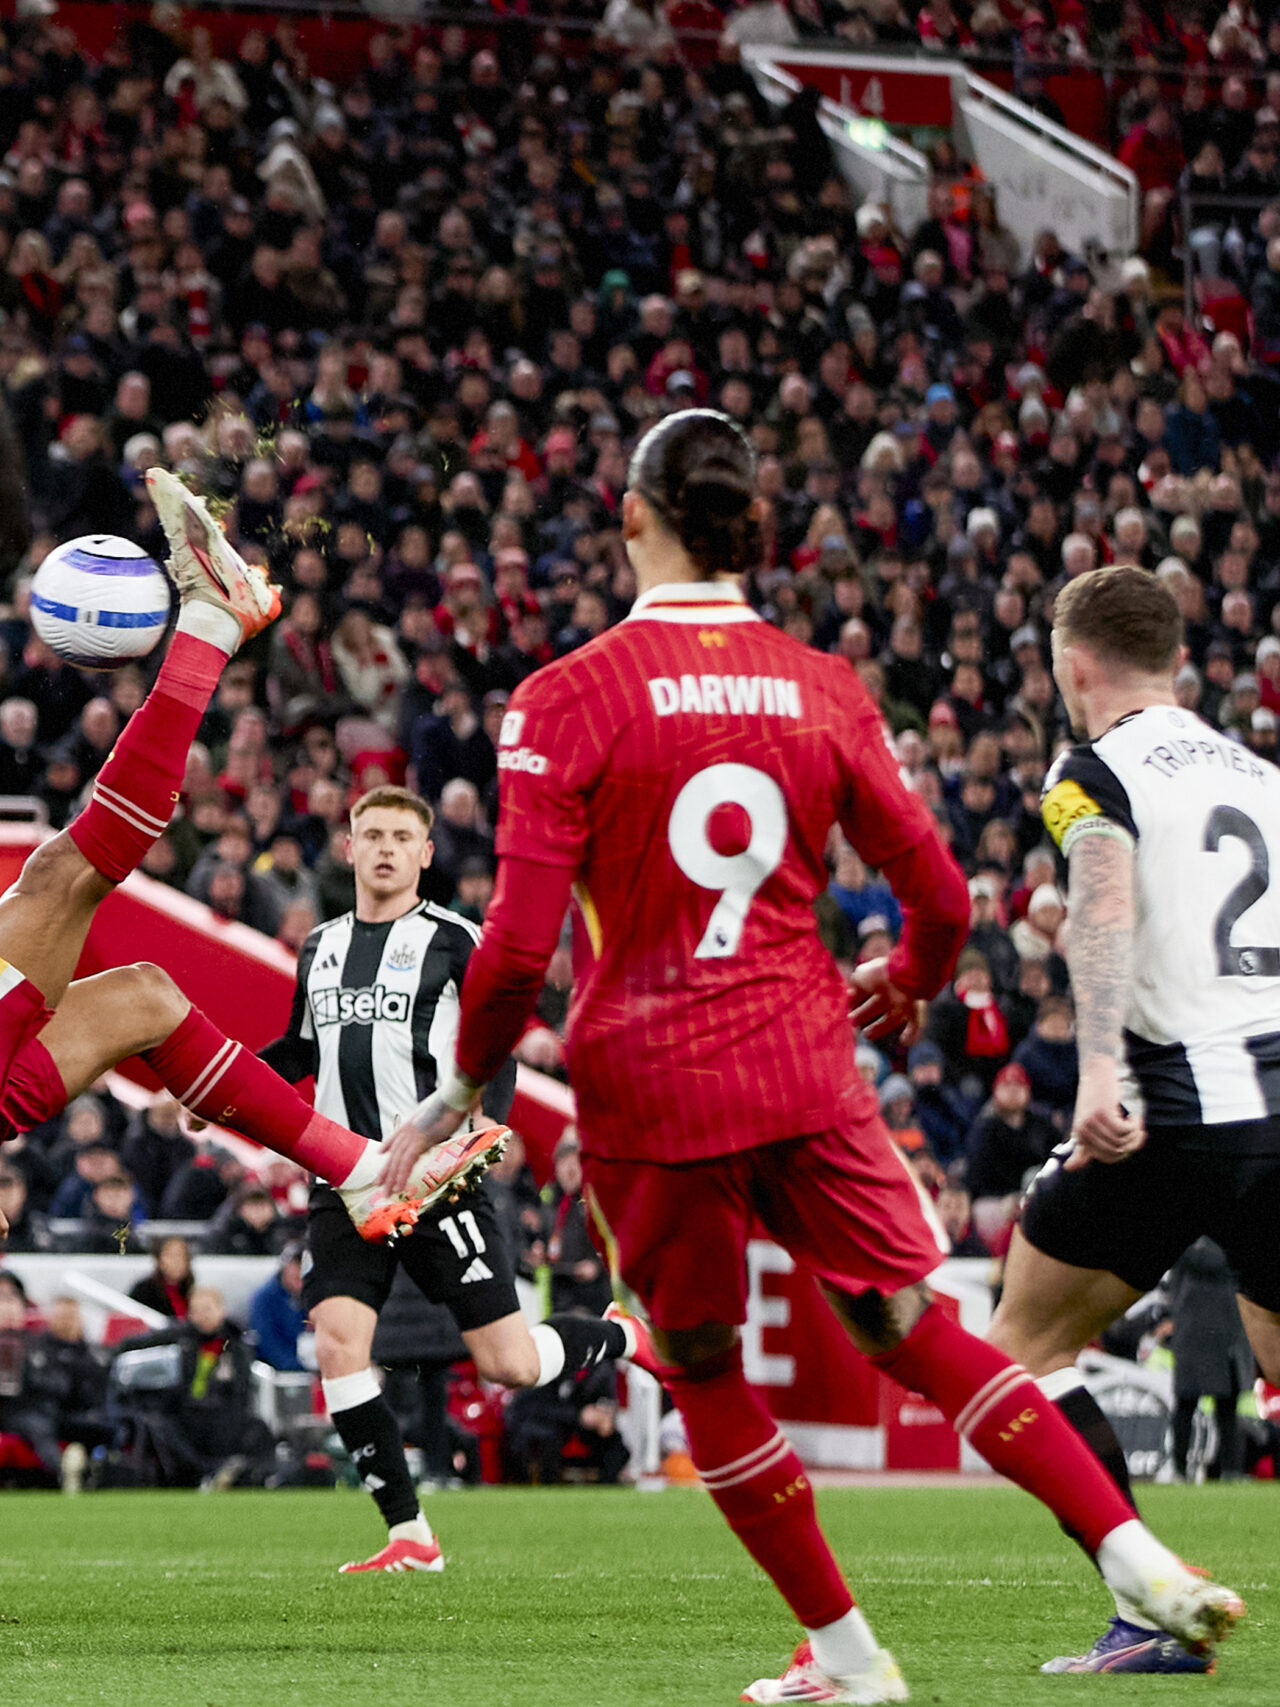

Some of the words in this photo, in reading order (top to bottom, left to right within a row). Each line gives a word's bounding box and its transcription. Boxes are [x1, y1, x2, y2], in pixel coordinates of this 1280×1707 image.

[648, 674, 803, 719] DARWIN
[1142, 739, 1266, 786] TRIPPIER
[668, 762, 788, 959] 9
[1203, 804, 1280, 977] 2
[339, 984, 410, 1022] sela
[438, 1209, 486, 1259] 11
